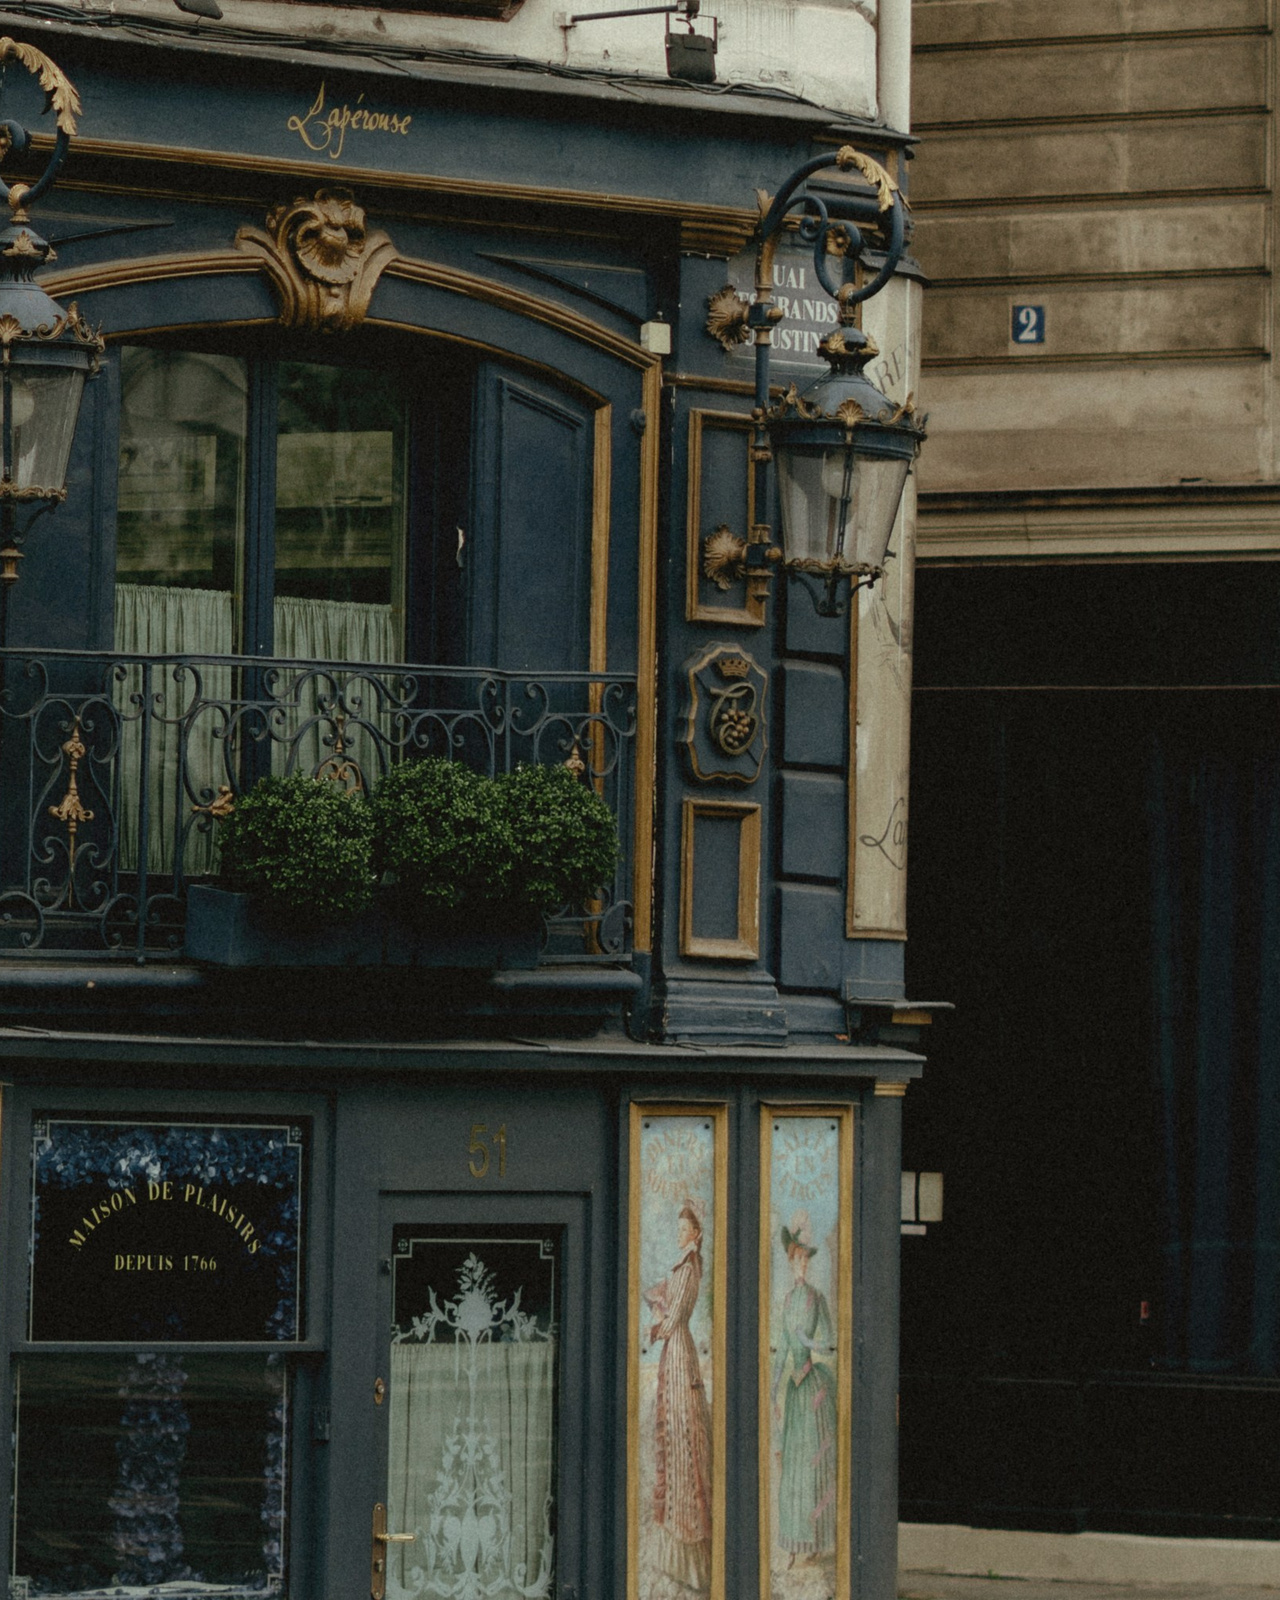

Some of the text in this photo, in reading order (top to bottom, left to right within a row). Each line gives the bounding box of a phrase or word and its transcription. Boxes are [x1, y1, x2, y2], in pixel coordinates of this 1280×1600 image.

[287, 81, 412, 159] Lapérouse
[772, 265, 806, 290] UAI
[770, 295, 838, 324] RANDS
[1019, 307, 1037, 340] 2
[468, 1123, 507, 1178] 51
[69, 1181, 262, 1255] MAISON DE PLAISIRS
[114, 1254, 218, 1272] DEPUIS 1766
